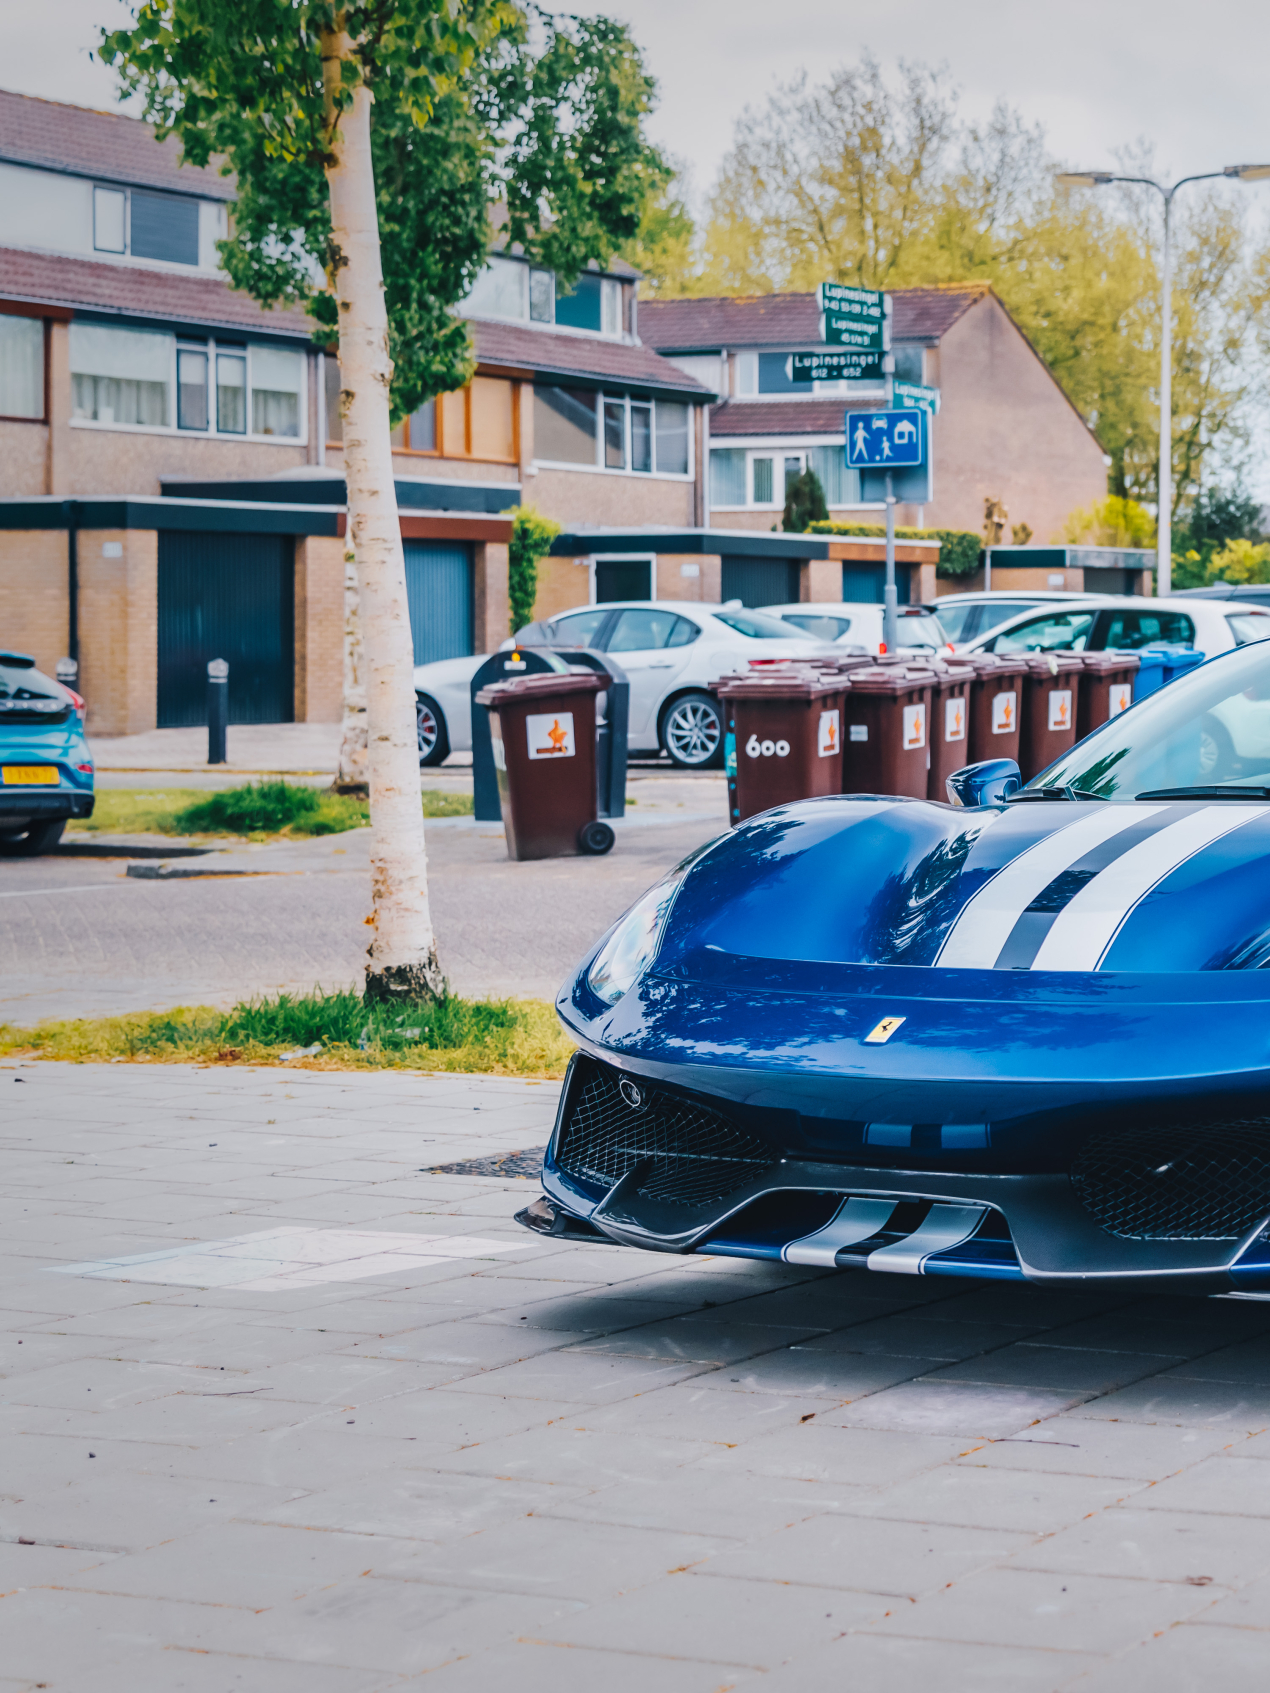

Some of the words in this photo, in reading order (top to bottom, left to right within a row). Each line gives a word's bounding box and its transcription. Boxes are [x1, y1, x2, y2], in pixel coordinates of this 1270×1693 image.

[825, 284, 879, 305] Lupinesingel
[831, 317, 878, 335] Lupinesingel
[794, 354, 878, 368] Lupinesingel
[811, 368, 828, 378] 612
[842, 367, 862, 377] 652
[745, 734, 791, 759] 600
